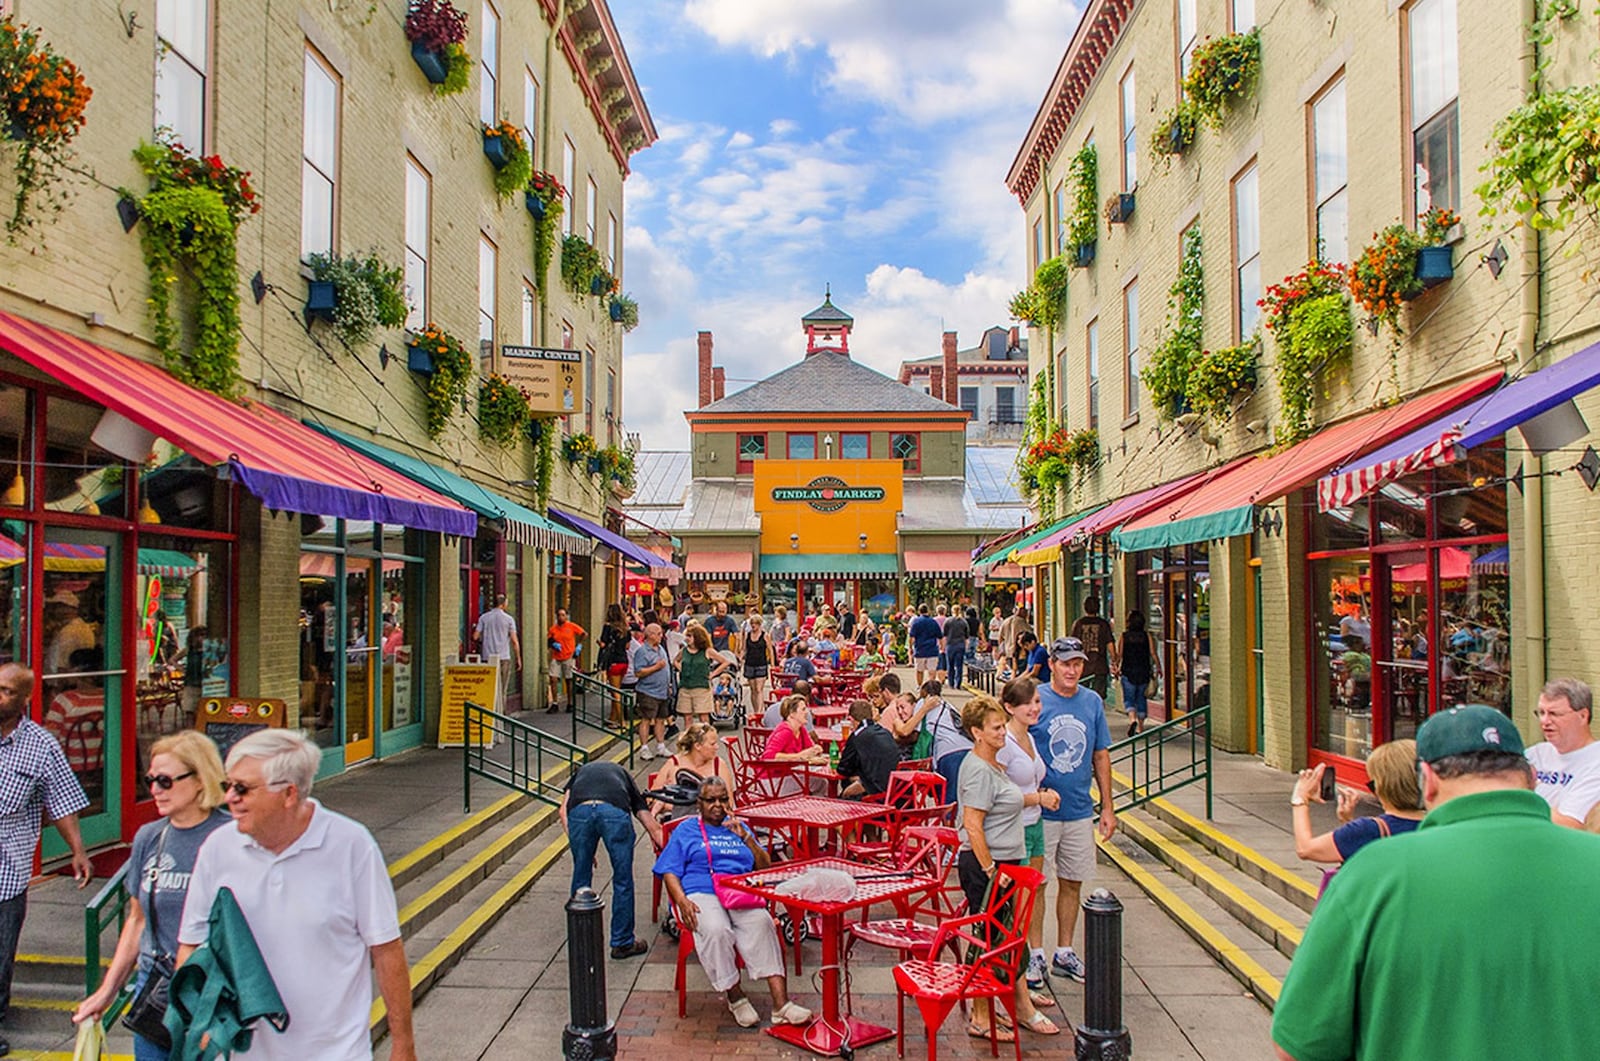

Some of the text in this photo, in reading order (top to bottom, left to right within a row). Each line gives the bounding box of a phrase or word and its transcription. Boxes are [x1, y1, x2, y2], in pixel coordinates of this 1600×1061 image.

[504, 347, 579, 361] MARKET CENTER
[508, 361, 544, 369] Restrooms
[775, 490, 882, 499] FINDLAY MARKET
